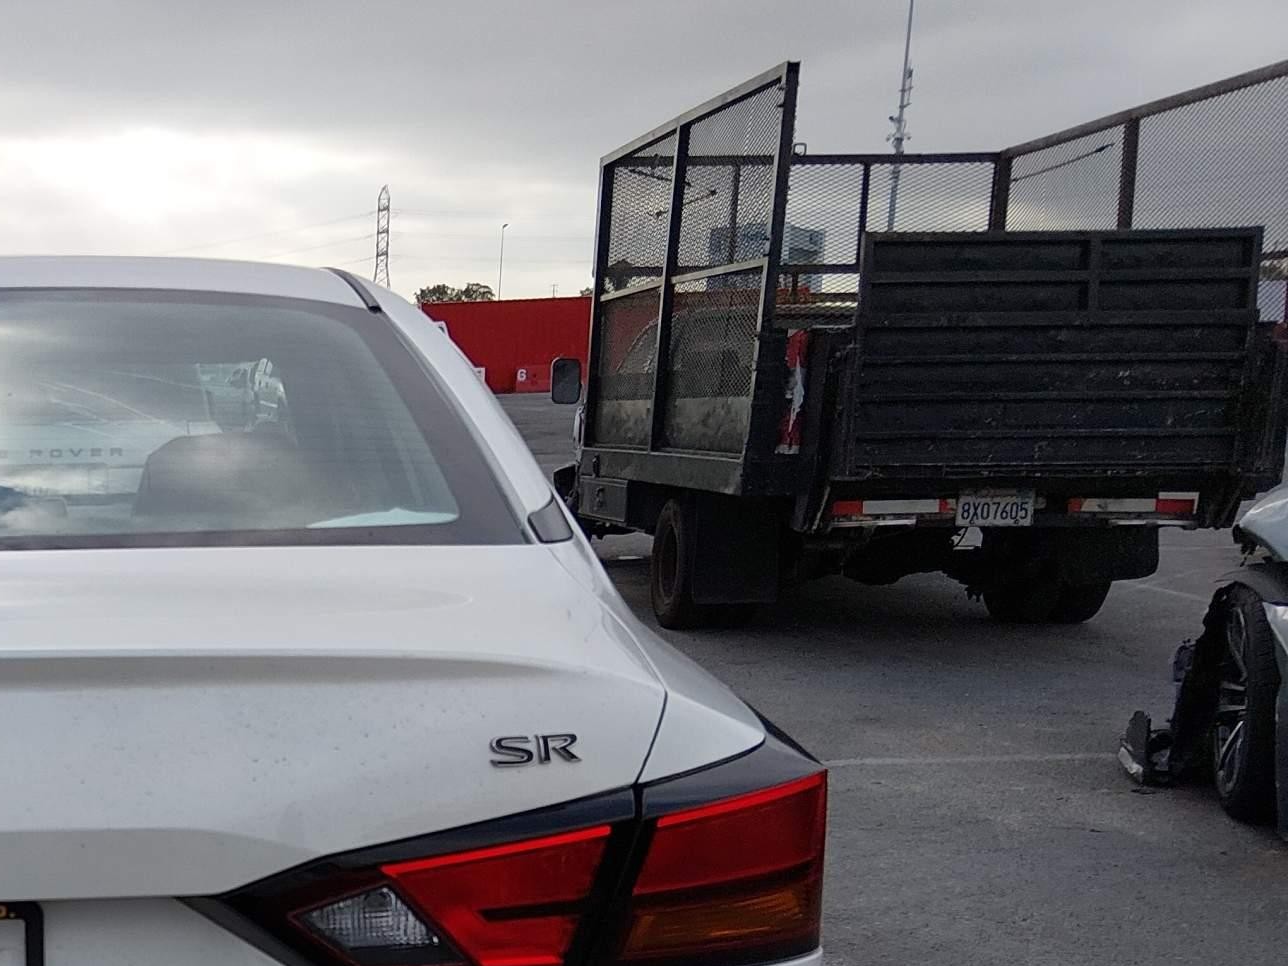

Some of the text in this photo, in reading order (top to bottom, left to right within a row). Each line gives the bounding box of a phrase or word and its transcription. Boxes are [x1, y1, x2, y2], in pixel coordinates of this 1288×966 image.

[29, 448, 123, 458] ROVER
[961, 502, 1029, 521] 8X07605
[489, 734, 582, 768] SR
